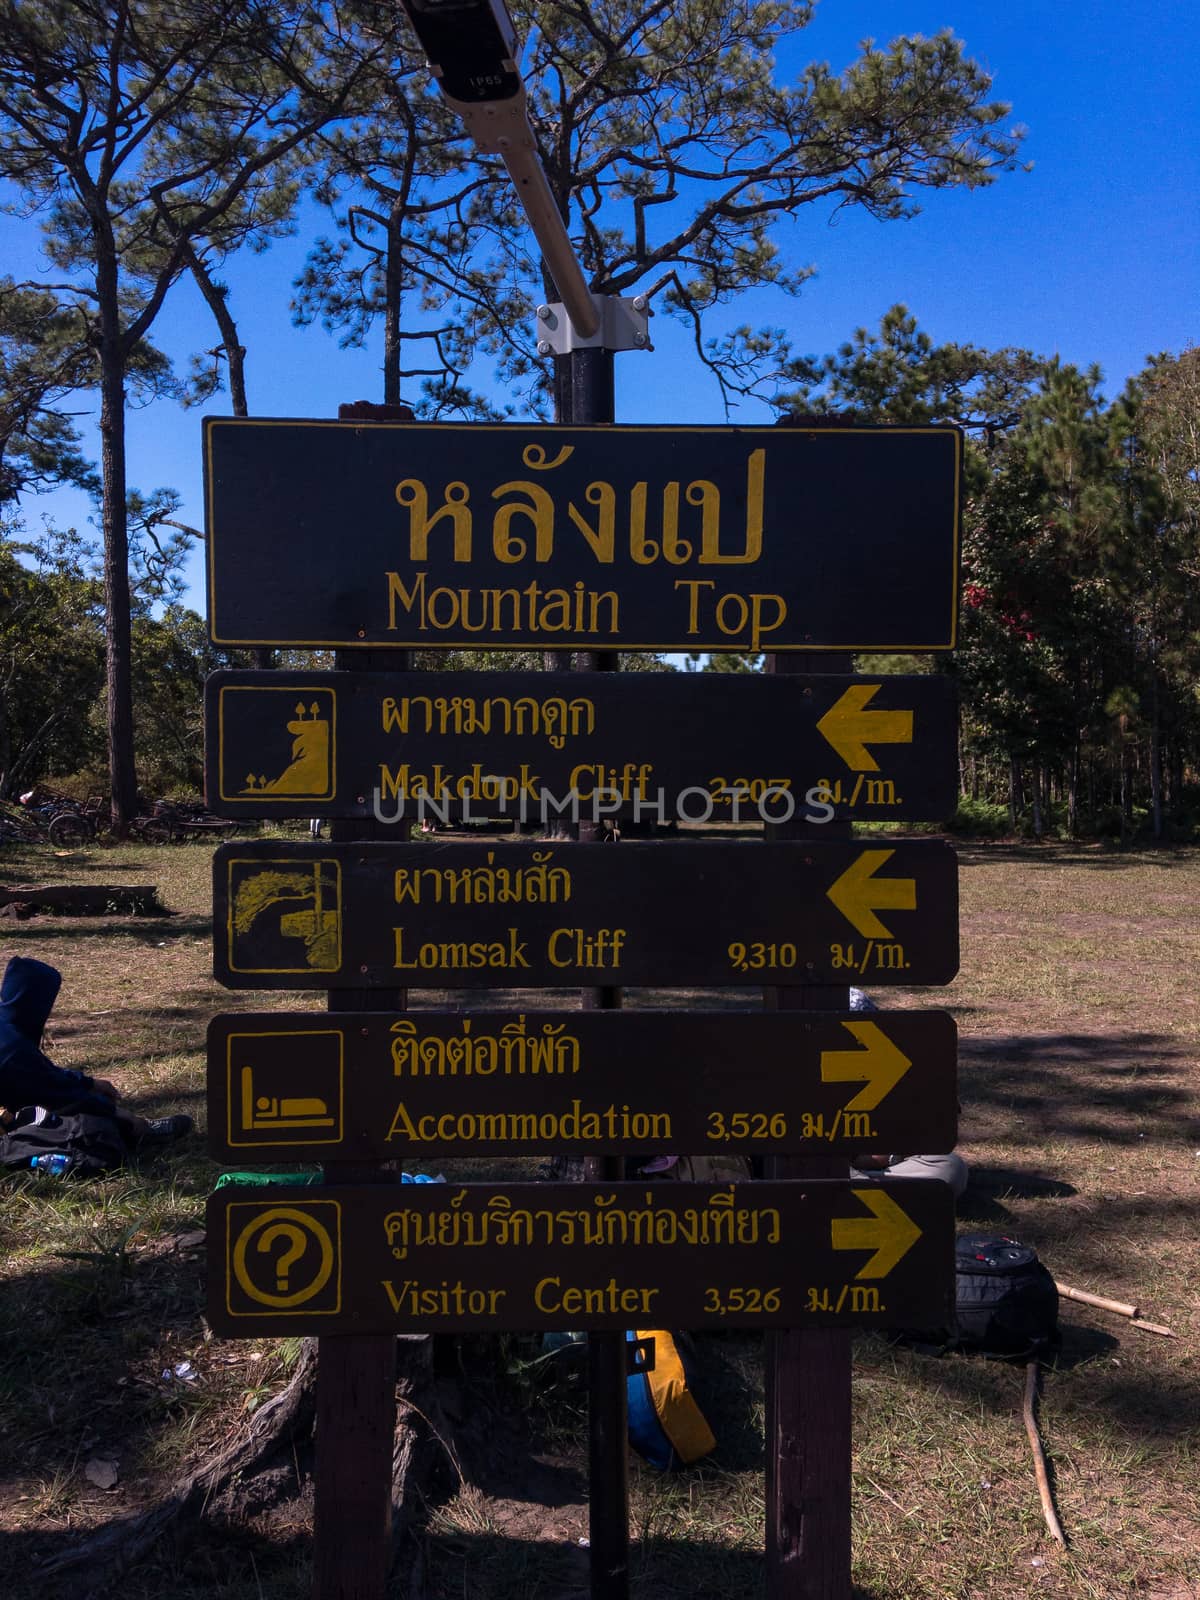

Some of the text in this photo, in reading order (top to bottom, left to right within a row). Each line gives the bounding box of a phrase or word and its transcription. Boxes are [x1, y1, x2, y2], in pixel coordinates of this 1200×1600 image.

[394, 443, 767, 566] หลังแป
[386, 570, 788, 651] Mountain Top
[380, 695, 596, 750] ผาหมากดูก
[378, 763, 542, 802] Makdook
[569, 763, 653, 802] Cliff
[708, 776, 792, 806] 2,207
[394, 851, 572, 904] ผาหล่มสัก
[392, 927, 531, 969] Lomsak
[547, 928, 626, 968] Cliff
[727, 942, 798, 971] 9,310
[389, 1014, 580, 1077] ติดต่อที่พัก
[384, 1099, 672, 1142] Accommodation
[706, 1111, 788, 1141] 3,526
[383, 1184, 782, 1259] ศูนย์บริการนักท่องเที่ยว
[381, 1279, 506, 1315] Visitor
[533, 1277, 659, 1314] Center
[703, 1287, 781, 1315] 3,526
